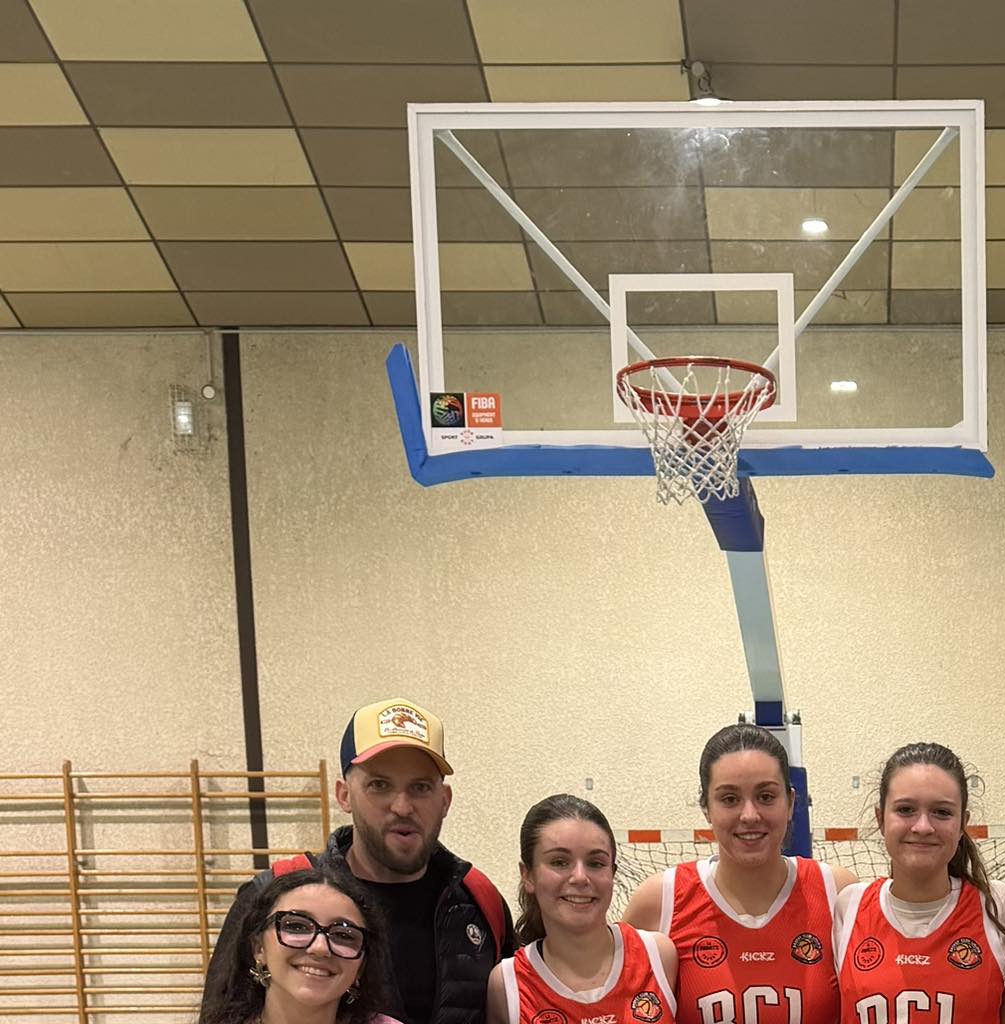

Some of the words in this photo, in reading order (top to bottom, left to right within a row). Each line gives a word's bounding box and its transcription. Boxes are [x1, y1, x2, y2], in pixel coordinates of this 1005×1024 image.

[471, 396, 496, 409] FIBA
[739, 951, 775, 962] KICKZ
[896, 954, 931, 965] KICKZ
